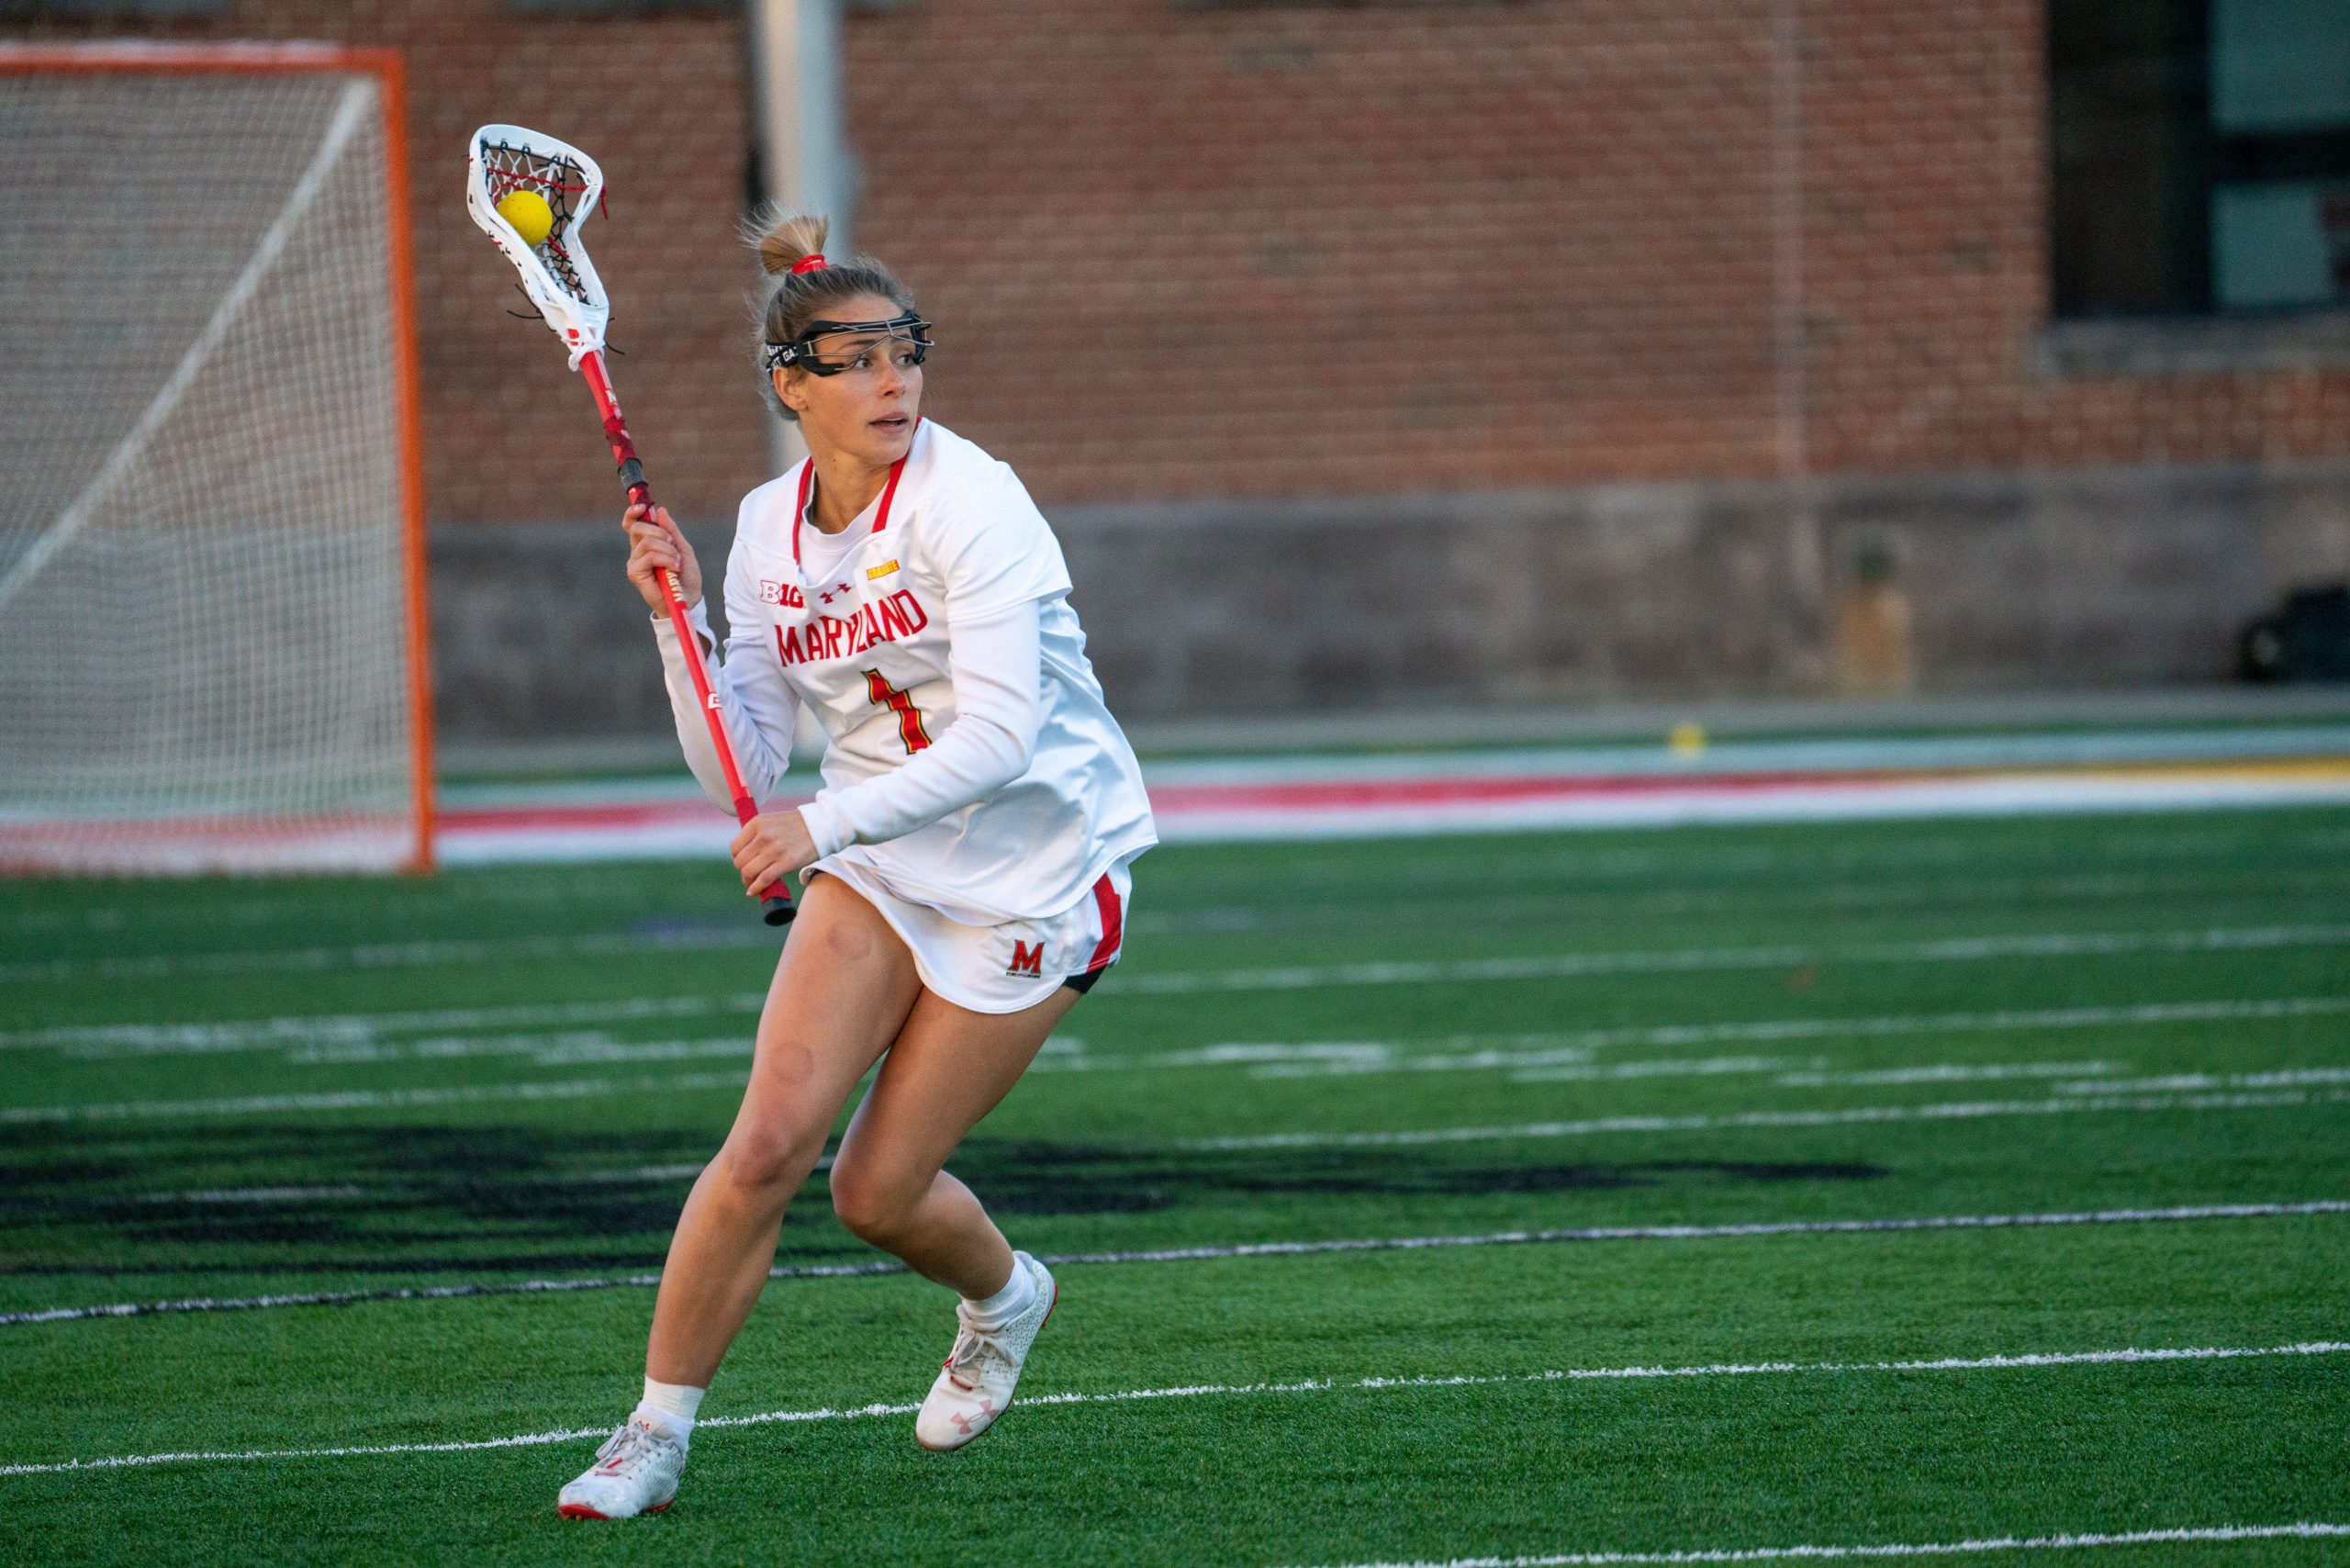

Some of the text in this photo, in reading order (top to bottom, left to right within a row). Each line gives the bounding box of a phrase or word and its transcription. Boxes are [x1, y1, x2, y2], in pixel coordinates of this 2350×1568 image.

[774, 588, 928, 667] MARYLAND
[861, 667, 933, 756] 1
[1007, 939, 1046, 975] M
